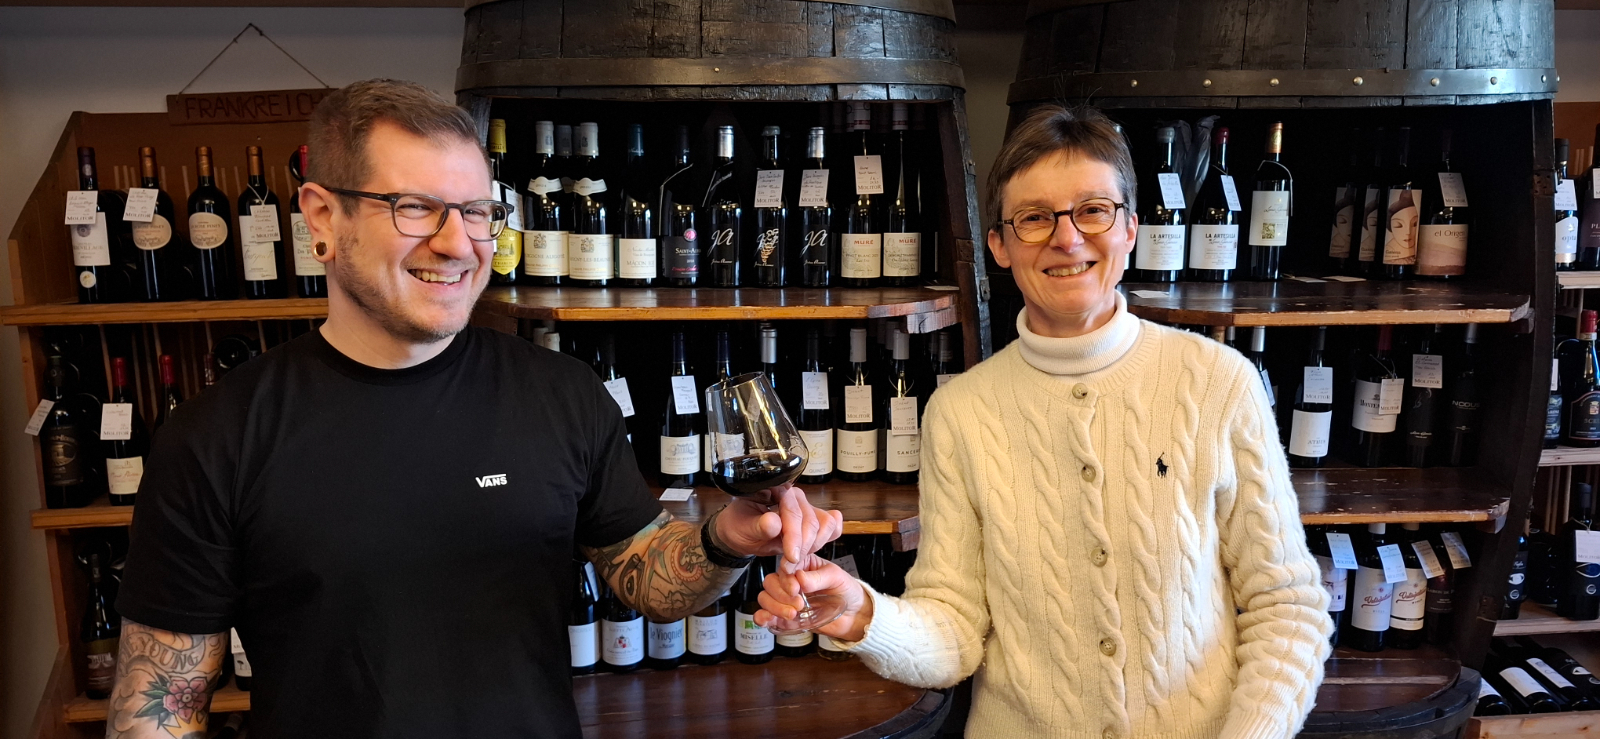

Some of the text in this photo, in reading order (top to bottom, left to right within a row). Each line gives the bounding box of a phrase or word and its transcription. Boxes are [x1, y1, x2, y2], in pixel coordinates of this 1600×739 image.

[475, 473, 508, 488] VANS
[650, 626, 684, 643] le Viognier
[138, 636, 200, 671] YOUNG
